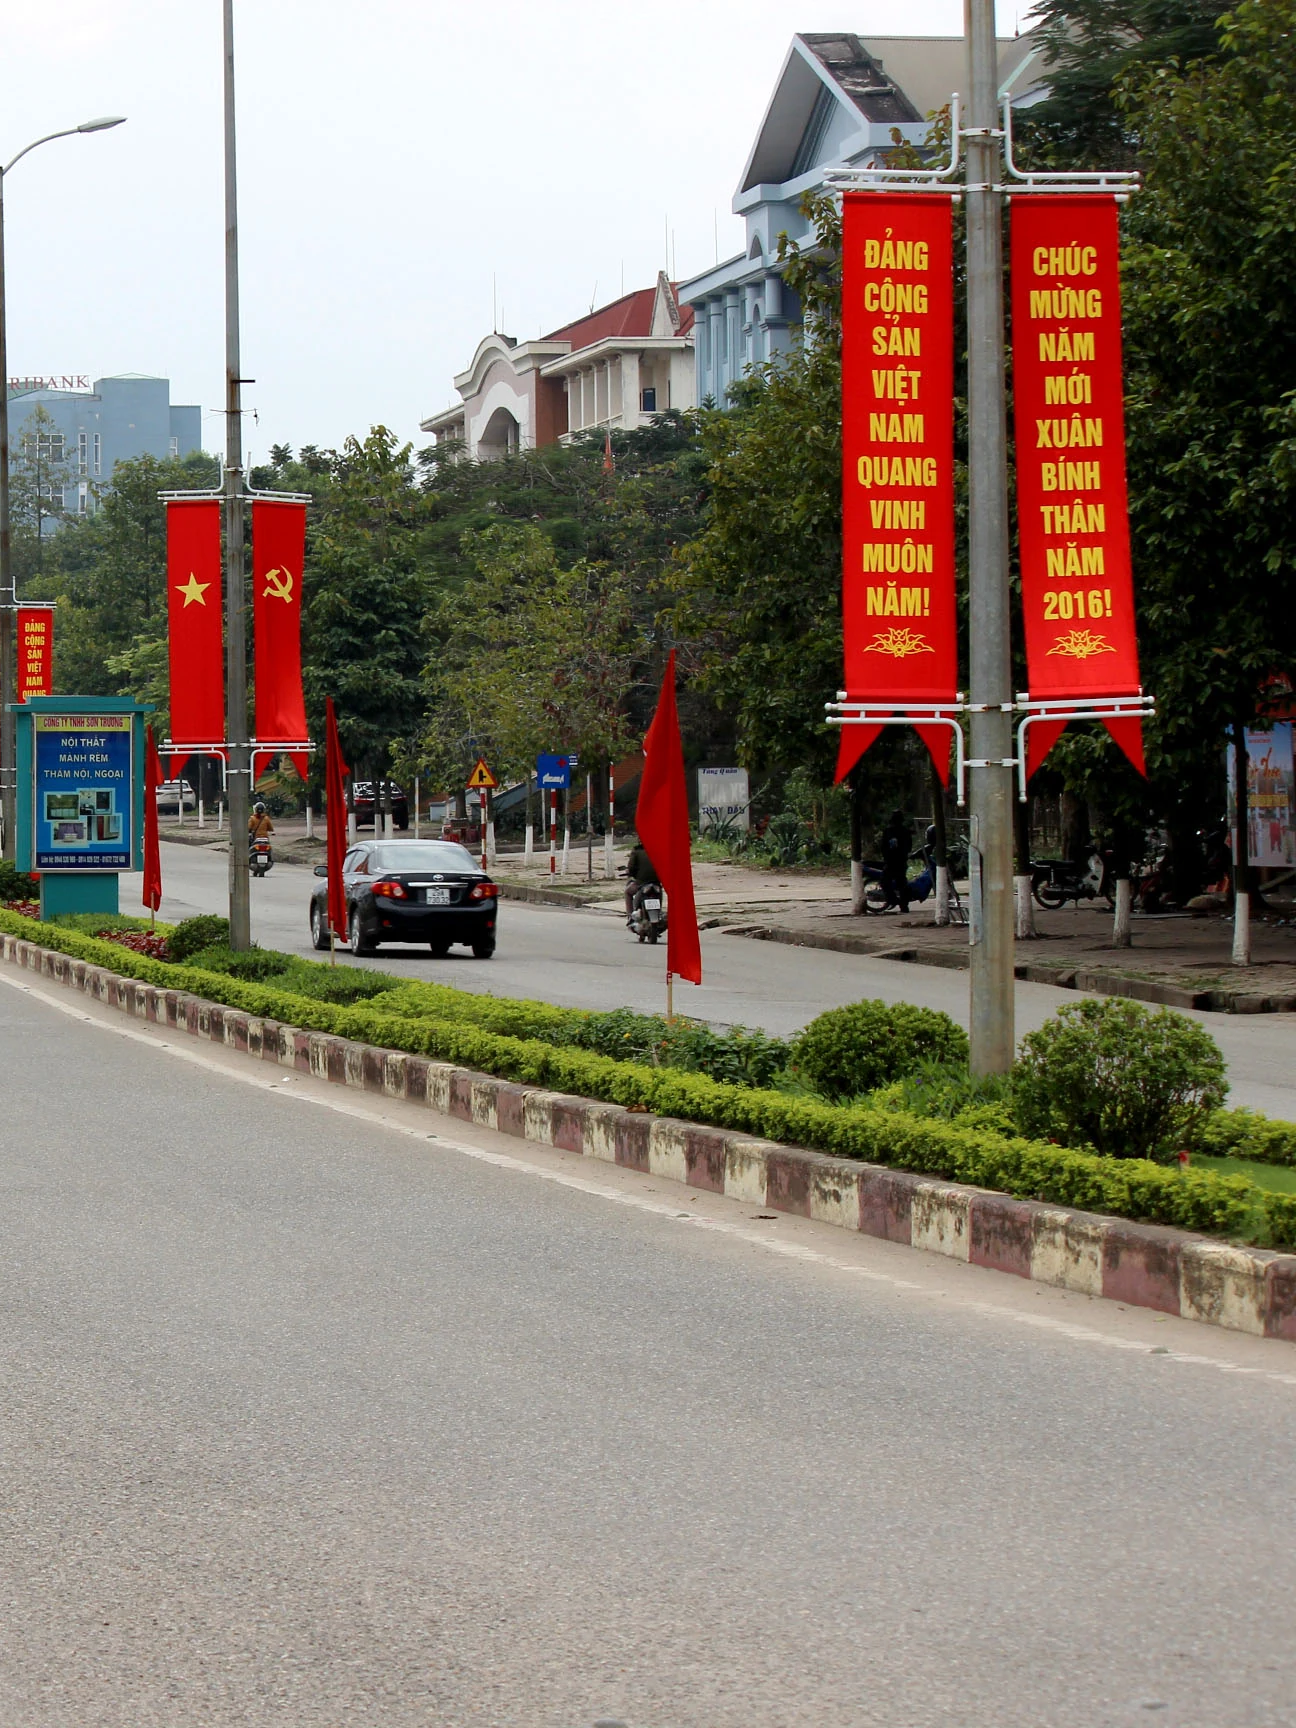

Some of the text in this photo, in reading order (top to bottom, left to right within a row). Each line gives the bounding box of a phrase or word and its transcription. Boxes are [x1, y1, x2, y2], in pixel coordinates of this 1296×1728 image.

[864, 228, 928, 271] ĐẢNG
[1033, 240, 1097, 276] CHÚC
[864, 277, 928, 320] CỘNG
[1030, 282, 1102, 319] MỪNG
[872, 313, 920, 357] SẢN
[1038, 323, 1095, 362] NĂM
[872, 365, 921, 406] VIỆT
[1044, 367, 1091, 404] MỚI
[869, 413, 924, 443] NAM
[1036, 411, 1102, 448] XUÂN
[857, 456, 937, 487] QUANG
[1041, 455, 1100, 492] BÍNH
[870, 500, 925, 530] VINH
[1040, 498, 1105, 534] THÂN
[863, 537, 933, 573] MUÔN
[1046, 540, 1104, 577] NĂM
[866, 580, 930, 617] NĂM!
[1043, 589, 1112, 621] 2016!
[24, 619, 46, 632] ĐẢNG
[24, 634, 45, 647] CỘNG
[26, 661, 42, 674] VIỆT
[27, 646, 42, 659] SẢN
[26, 676, 43, 686] NAM
[61, 736, 78, 749] NỘI
[94, 769, 124, 780] NGOẠI
